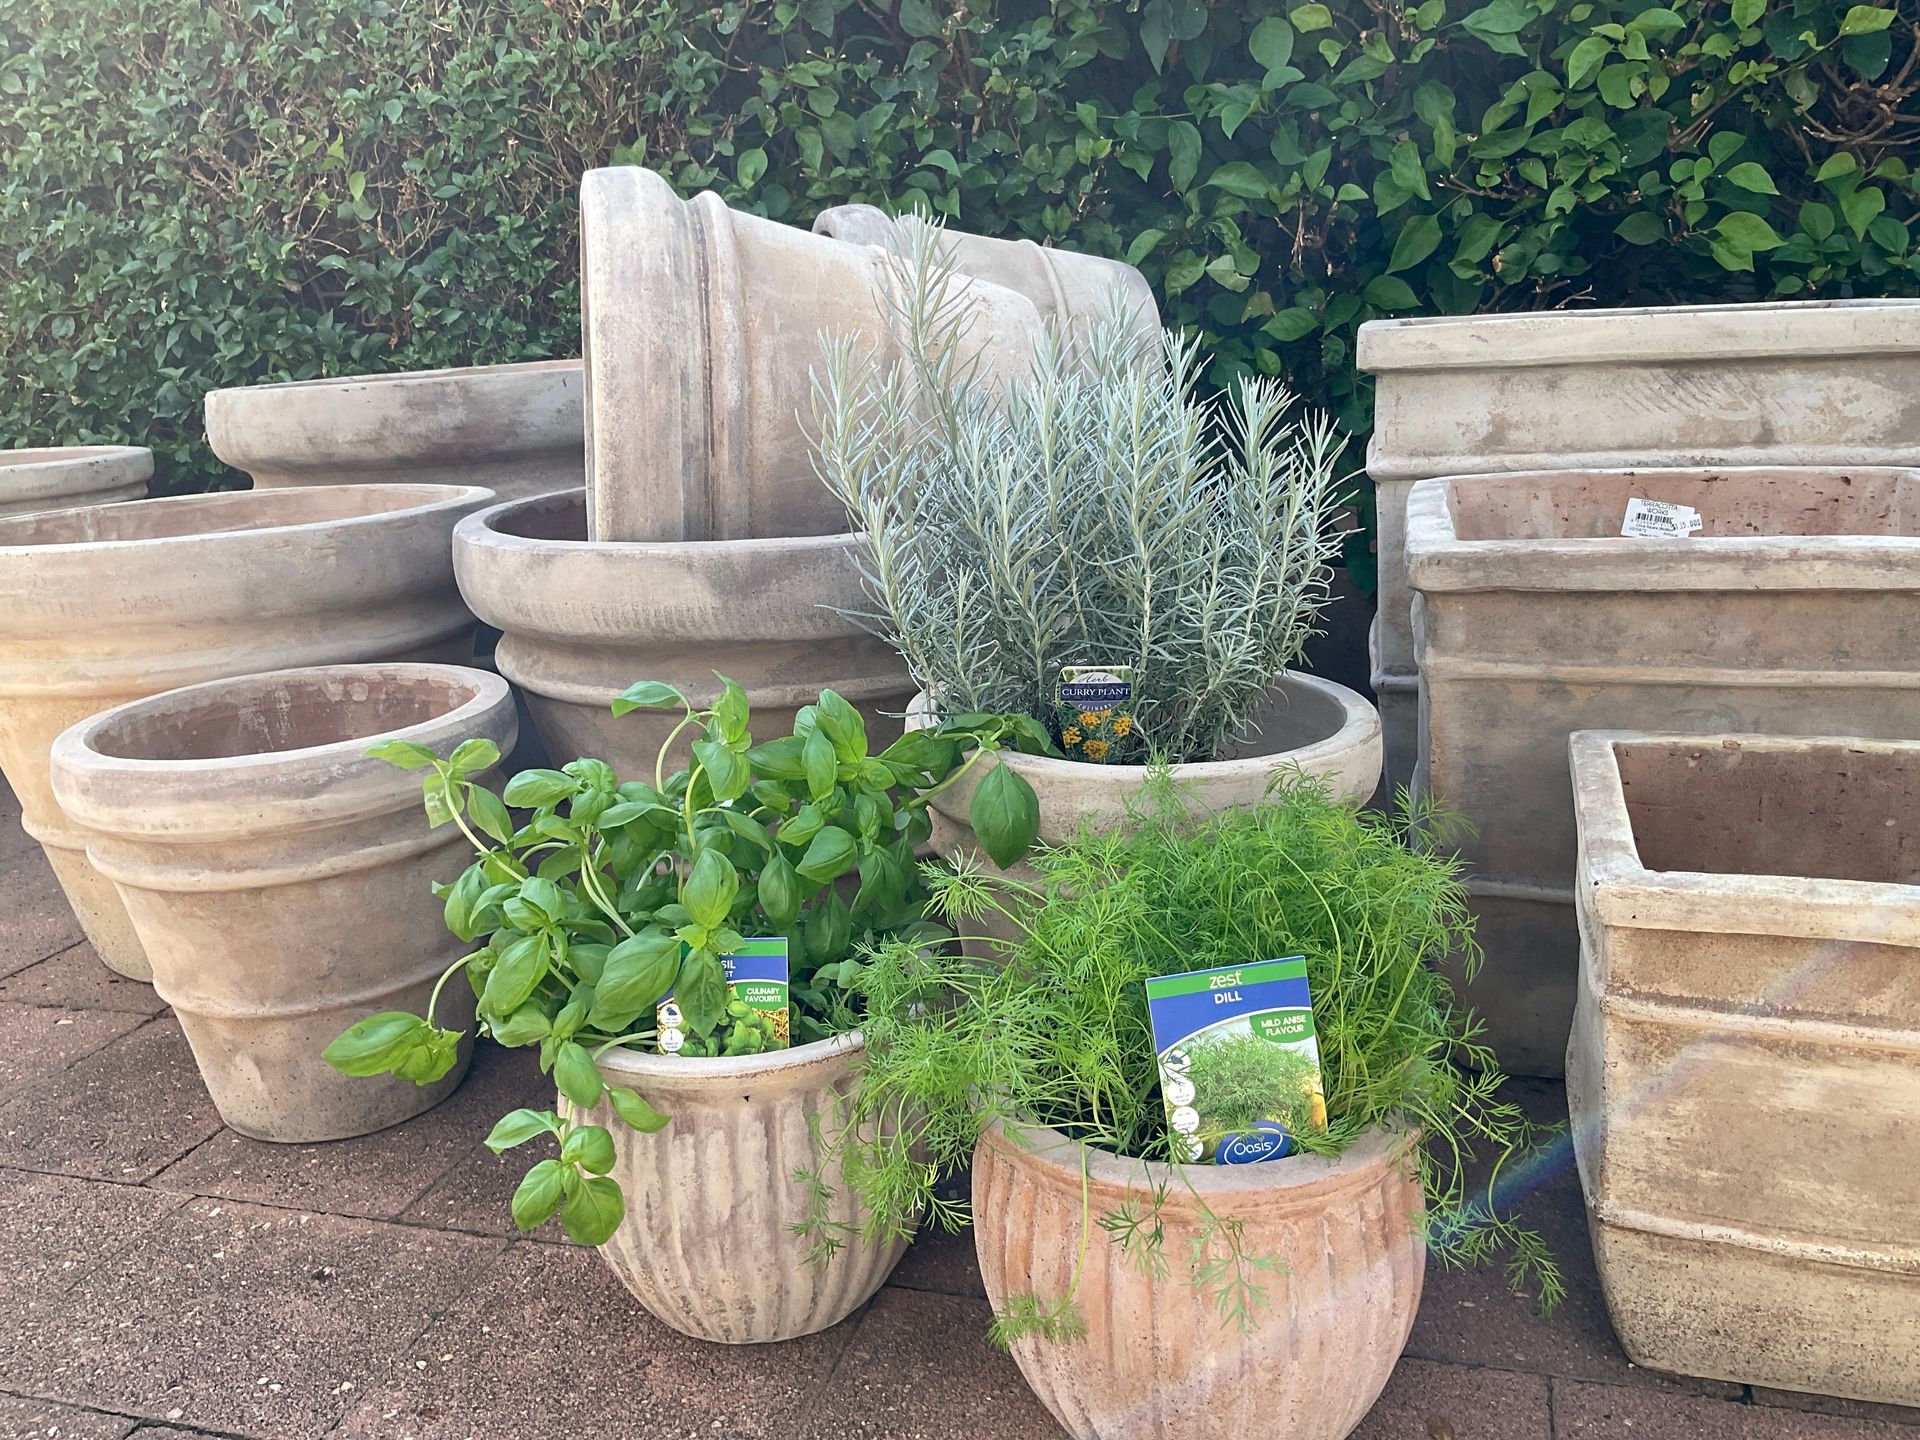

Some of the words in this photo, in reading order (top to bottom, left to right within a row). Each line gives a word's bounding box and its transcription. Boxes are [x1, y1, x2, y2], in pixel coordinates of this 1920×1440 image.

[1641, 500, 1678, 510] TERRACOTTA
[1646, 507, 1668, 516] WORKS
[1078, 674, 1109, 683] Herb
[1061, 688, 1096, 696] CURRY
[1098, 687, 1131, 695] PLANT
[720, 960, 736, 969] SIL
[1208, 970, 1243, 989] zest
[746, 987, 780, 995] CULINARY
[744, 995, 782, 1003] FAVOURITE
[1214, 991, 1243, 1004] DILL
[1261, 1018, 1281, 1028] MILD
[1282, 1015, 1307, 1025] ANISE
[1265, 1024, 1304, 1036] FLAVOUR
[1233, 1140, 1273, 1156] Oasis
